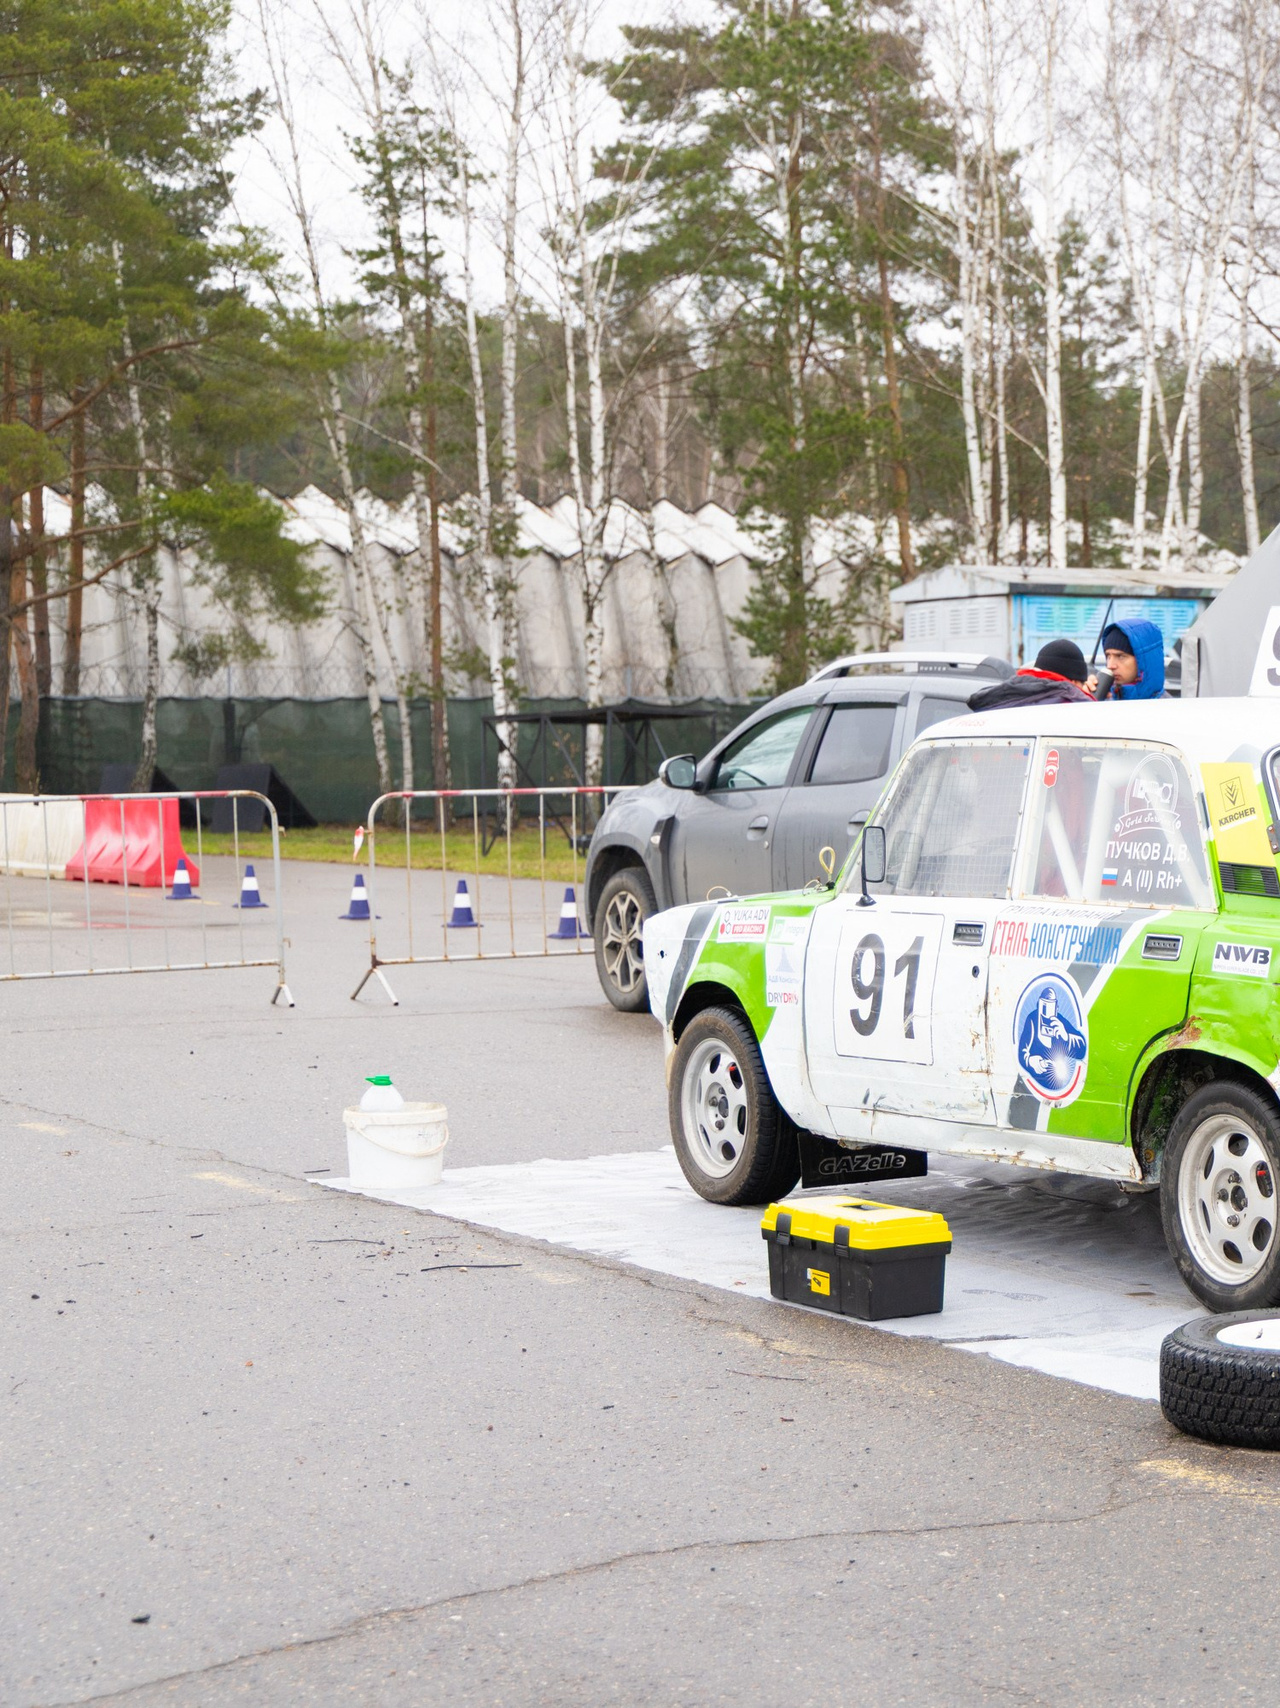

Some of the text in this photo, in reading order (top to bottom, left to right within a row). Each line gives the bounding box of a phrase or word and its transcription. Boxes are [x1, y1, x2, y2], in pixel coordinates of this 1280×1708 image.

[1104, 841, 1190, 865] ПУЧКОВ Д.В.
[1121, 869, 1183, 893] A (II) Rh+
[733, 908, 770, 921] YUKA ADV
[1214, 943, 1270, 965] NWB
[849, 933, 925, 1040] 91
[818, 1151, 907, 1177] GAZelle
